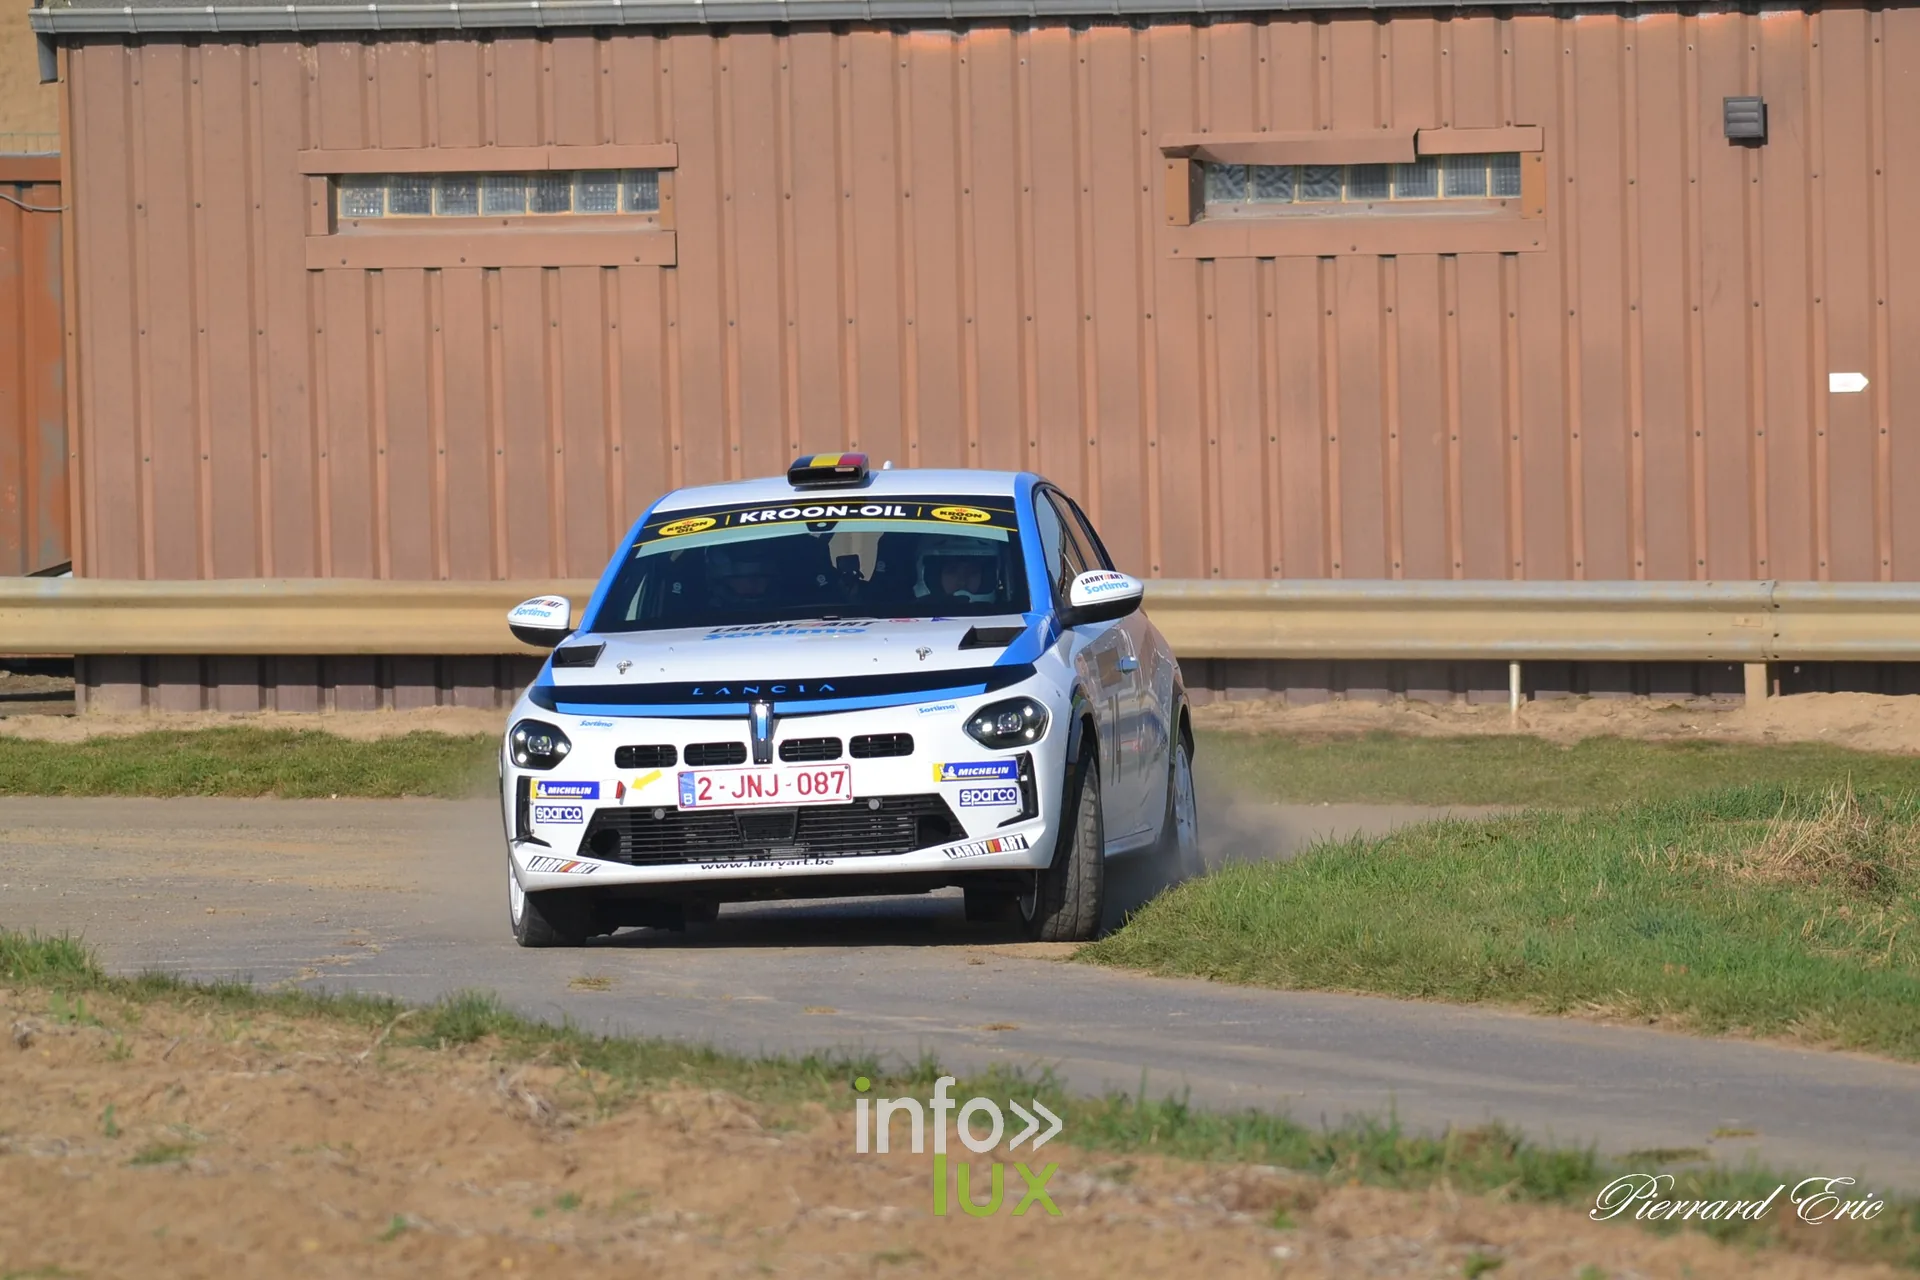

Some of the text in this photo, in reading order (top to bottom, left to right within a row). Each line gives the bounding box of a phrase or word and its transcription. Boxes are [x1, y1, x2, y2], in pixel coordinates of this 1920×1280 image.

[739, 505, 907, 524] KROON-OIL
[939, 510, 982, 518] KROON
[666, 520, 709, 532] KROON
[1084, 581, 1129, 595] Sortimo
[703, 628, 866, 641] Sortimo
[692, 683, 836, 696] LANCIA
[918, 703, 956, 714] Sortimo
[579, 720, 613, 728] Sortimo
[957, 766, 1009, 776] MICHELIN
[547, 786, 593, 795] MICHELIN
[697, 770, 845, 801] 2-JNJ-087
[683, 793, 693, 805] B
[960, 788, 1017, 806] sparco
[535, 807, 583, 824] sparco
[946, 834, 1025, 859] LARRY ART
